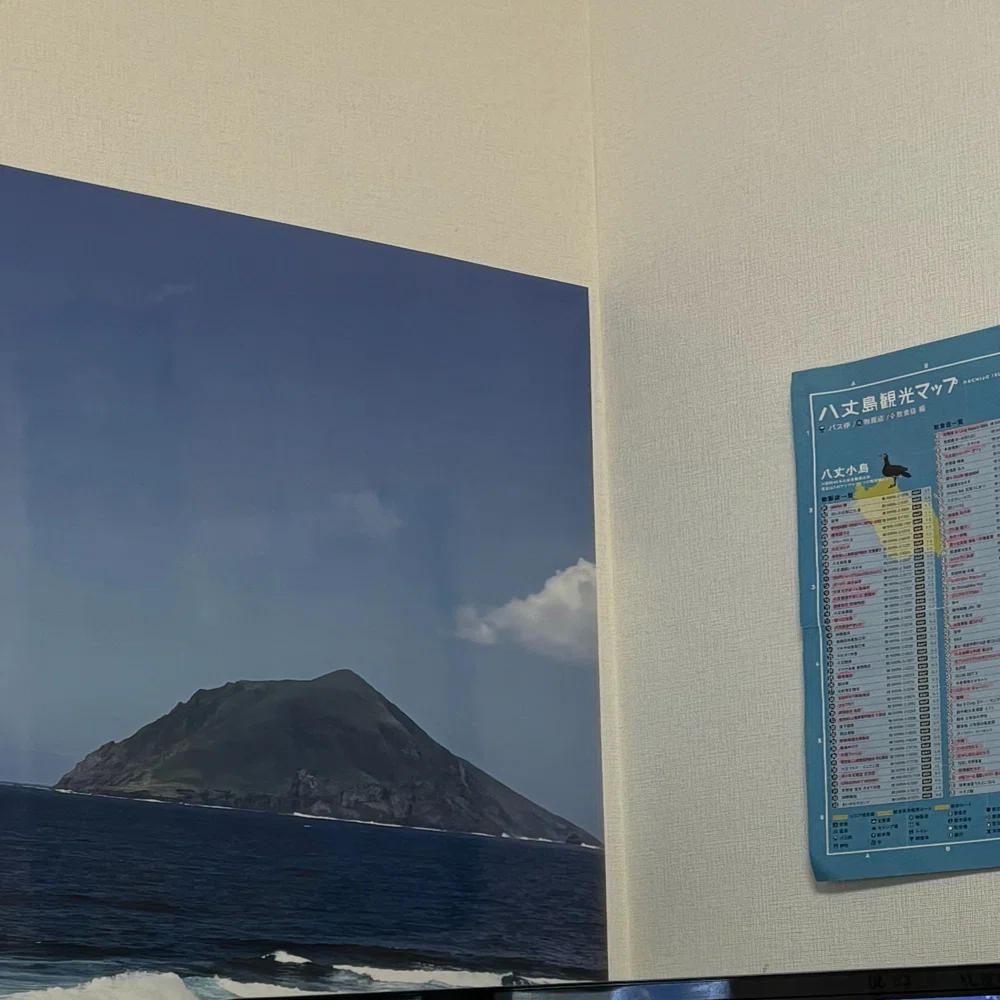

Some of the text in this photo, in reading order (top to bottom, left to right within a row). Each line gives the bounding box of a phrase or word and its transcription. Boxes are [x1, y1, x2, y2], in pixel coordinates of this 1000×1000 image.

[818, 377, 959, 422] 八丈島観光マップ
[821, 463, 869, 480] 八丈小島
